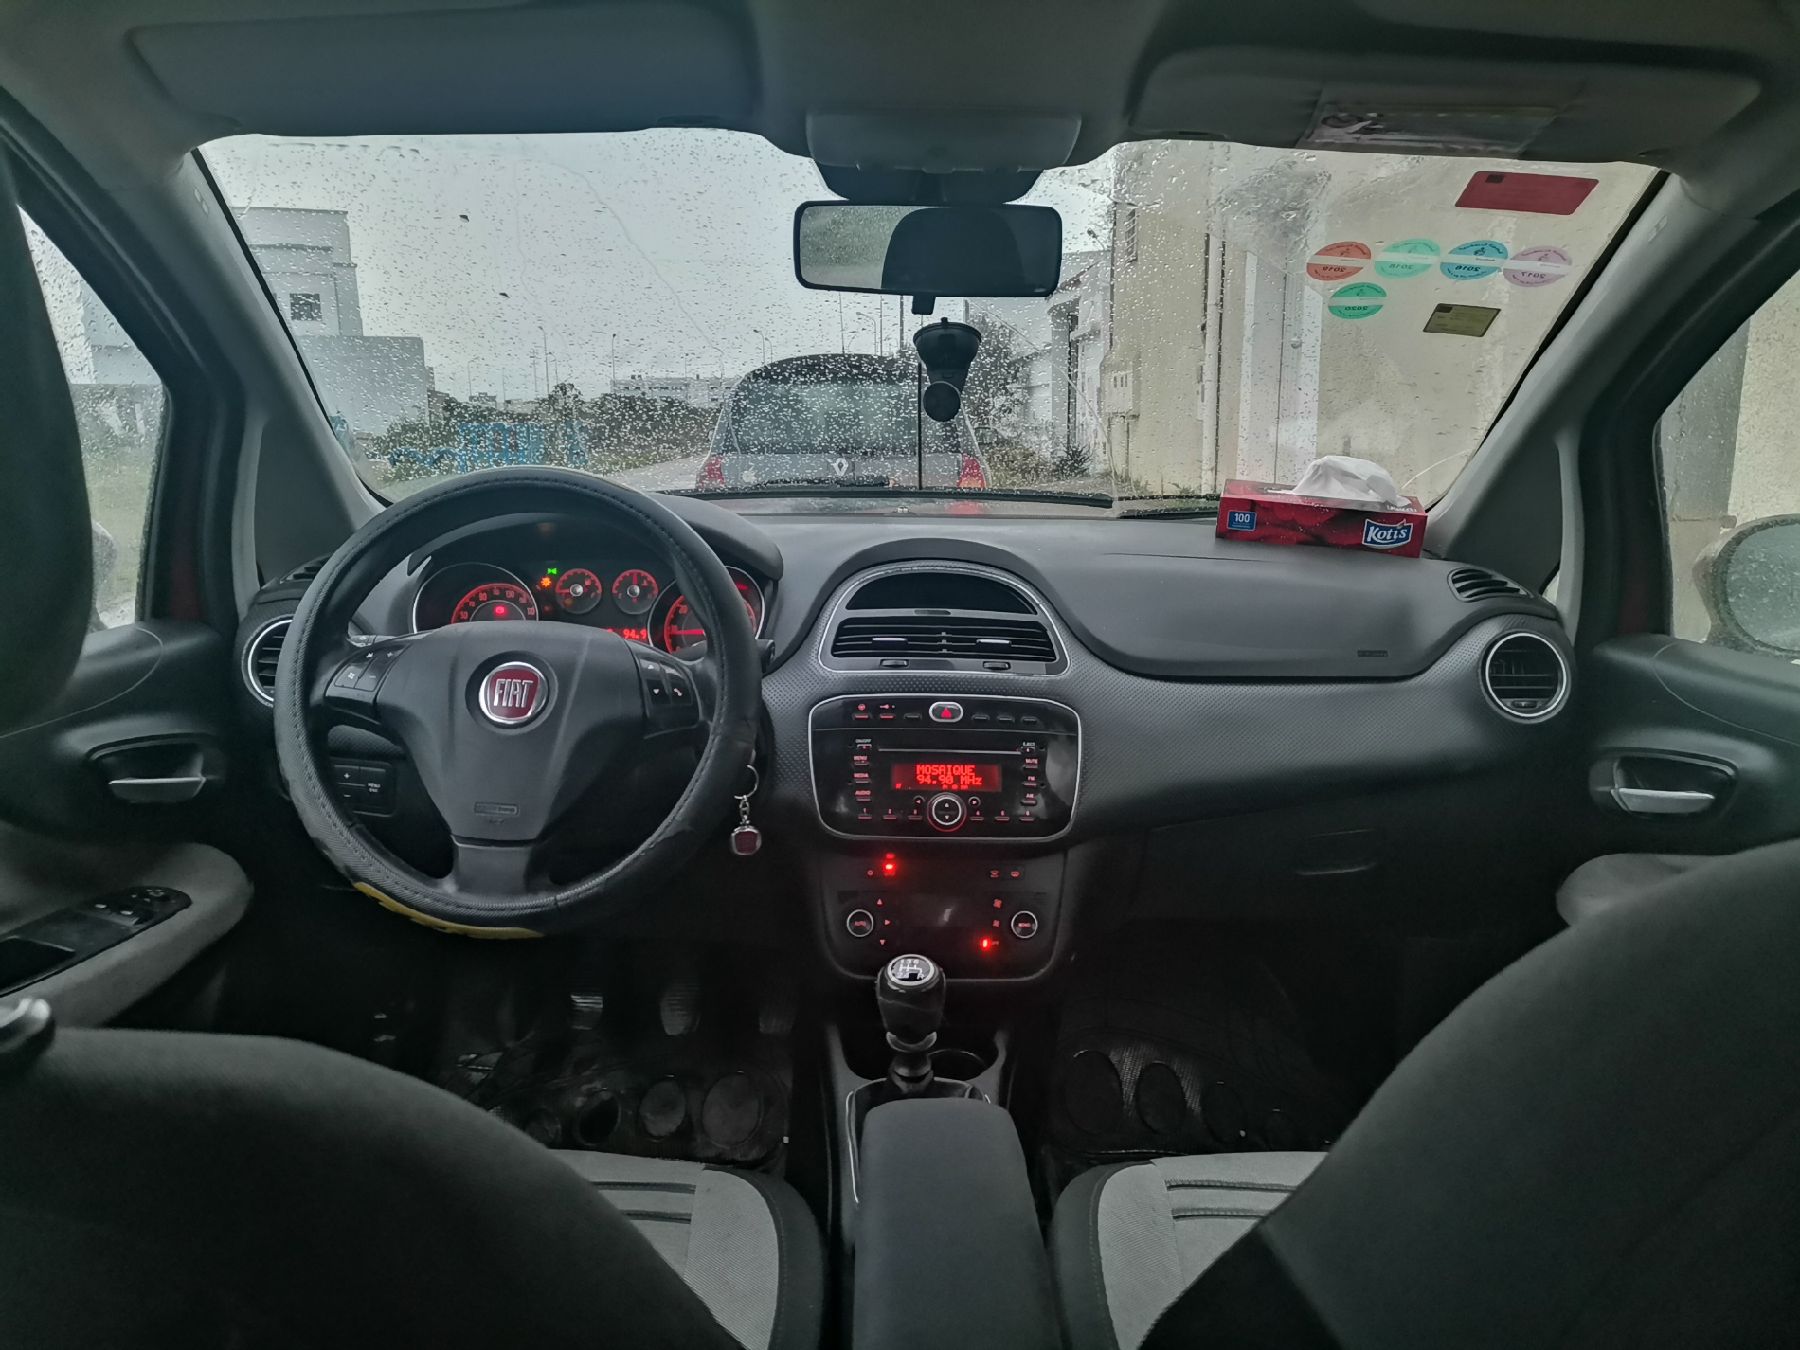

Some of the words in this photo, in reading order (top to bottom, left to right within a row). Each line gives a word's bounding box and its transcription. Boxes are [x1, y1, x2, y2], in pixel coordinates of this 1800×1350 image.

[1234, 512, 1251, 523] 100
[493, 678, 534, 708] FIAT
[916, 764, 976, 775] MOSAIQUE
[916, 774, 954, 785] 94.90
[960, 774, 982, 785] MHz
